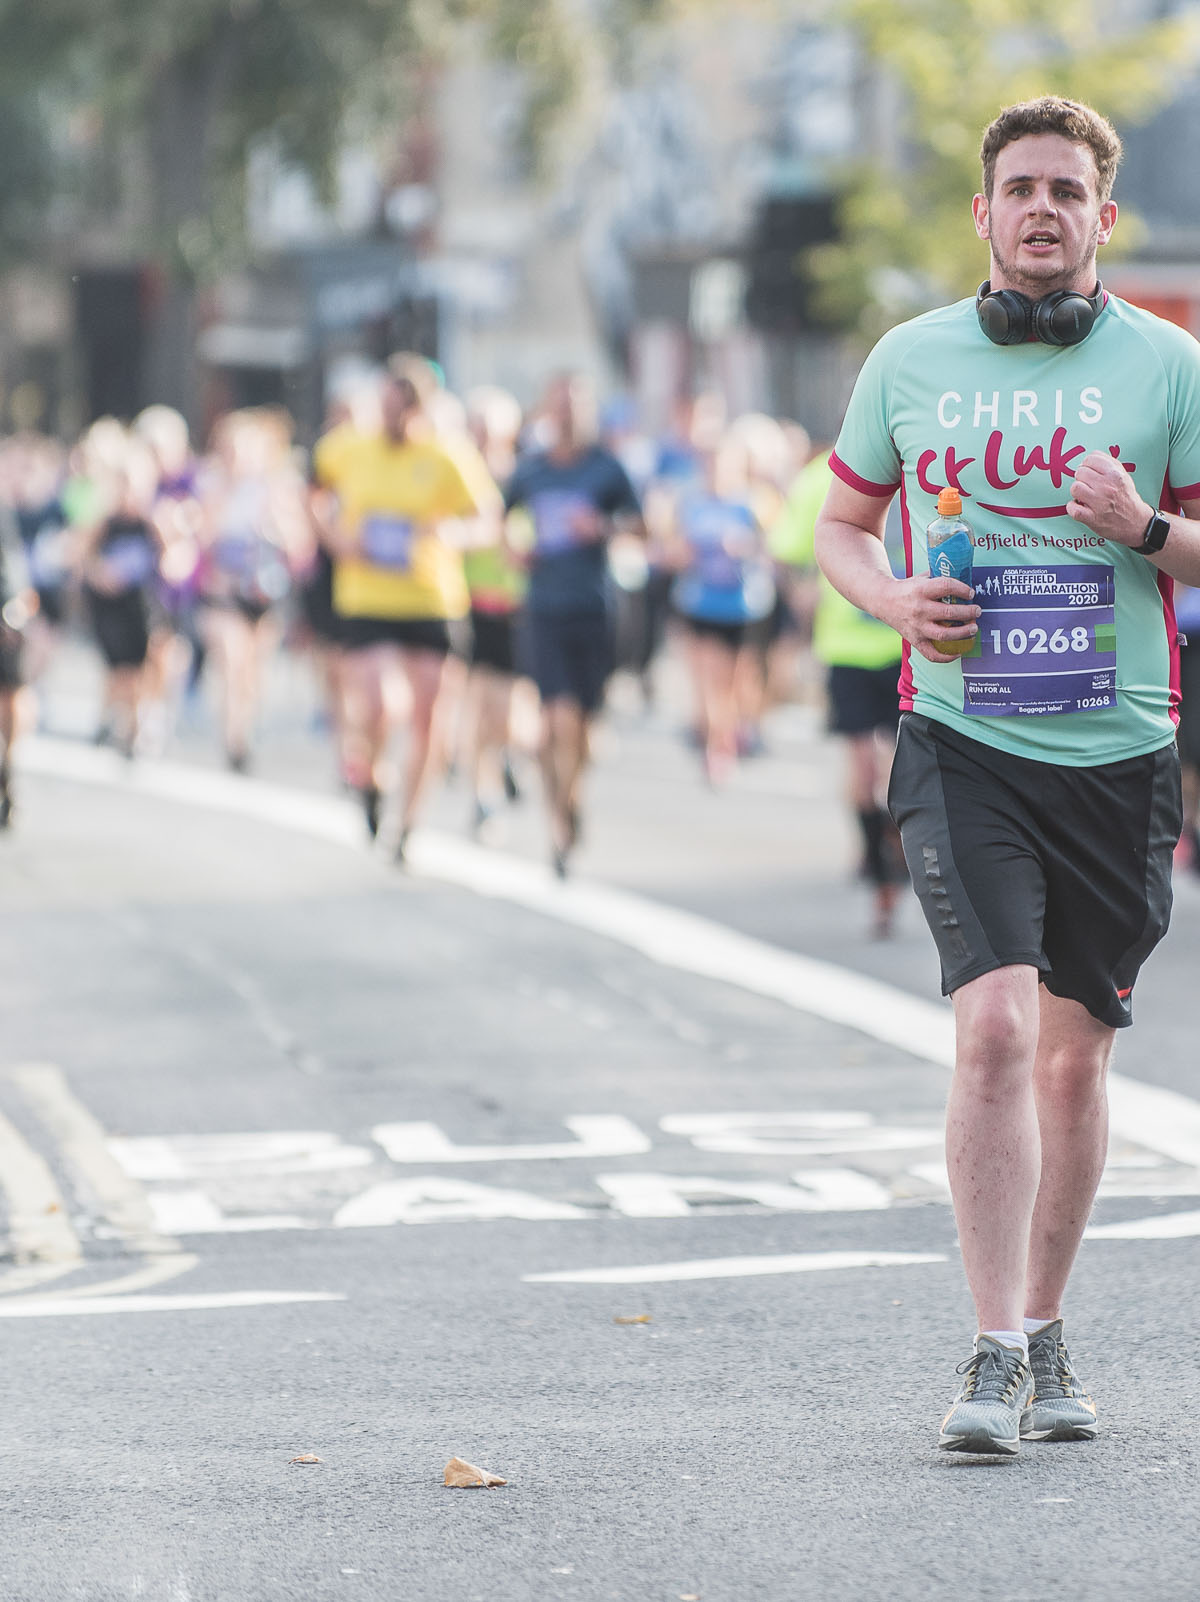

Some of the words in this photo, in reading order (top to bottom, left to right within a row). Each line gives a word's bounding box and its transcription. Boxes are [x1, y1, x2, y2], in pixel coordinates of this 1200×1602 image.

[937, 386, 1104, 429] CHRIS
[1042, 534, 1106, 551] Hospice
[1003, 575, 1055, 585] SHEFFIELD
[1004, 585, 1032, 595] HALF
[1033, 584, 1098, 595] MARATHON
[1068, 595, 1099, 605] 2020
[990, 626, 1090, 655] 10268
[1076, 696, 1110, 709] 10268
[1019, 706, 1046, 714] Baggage
